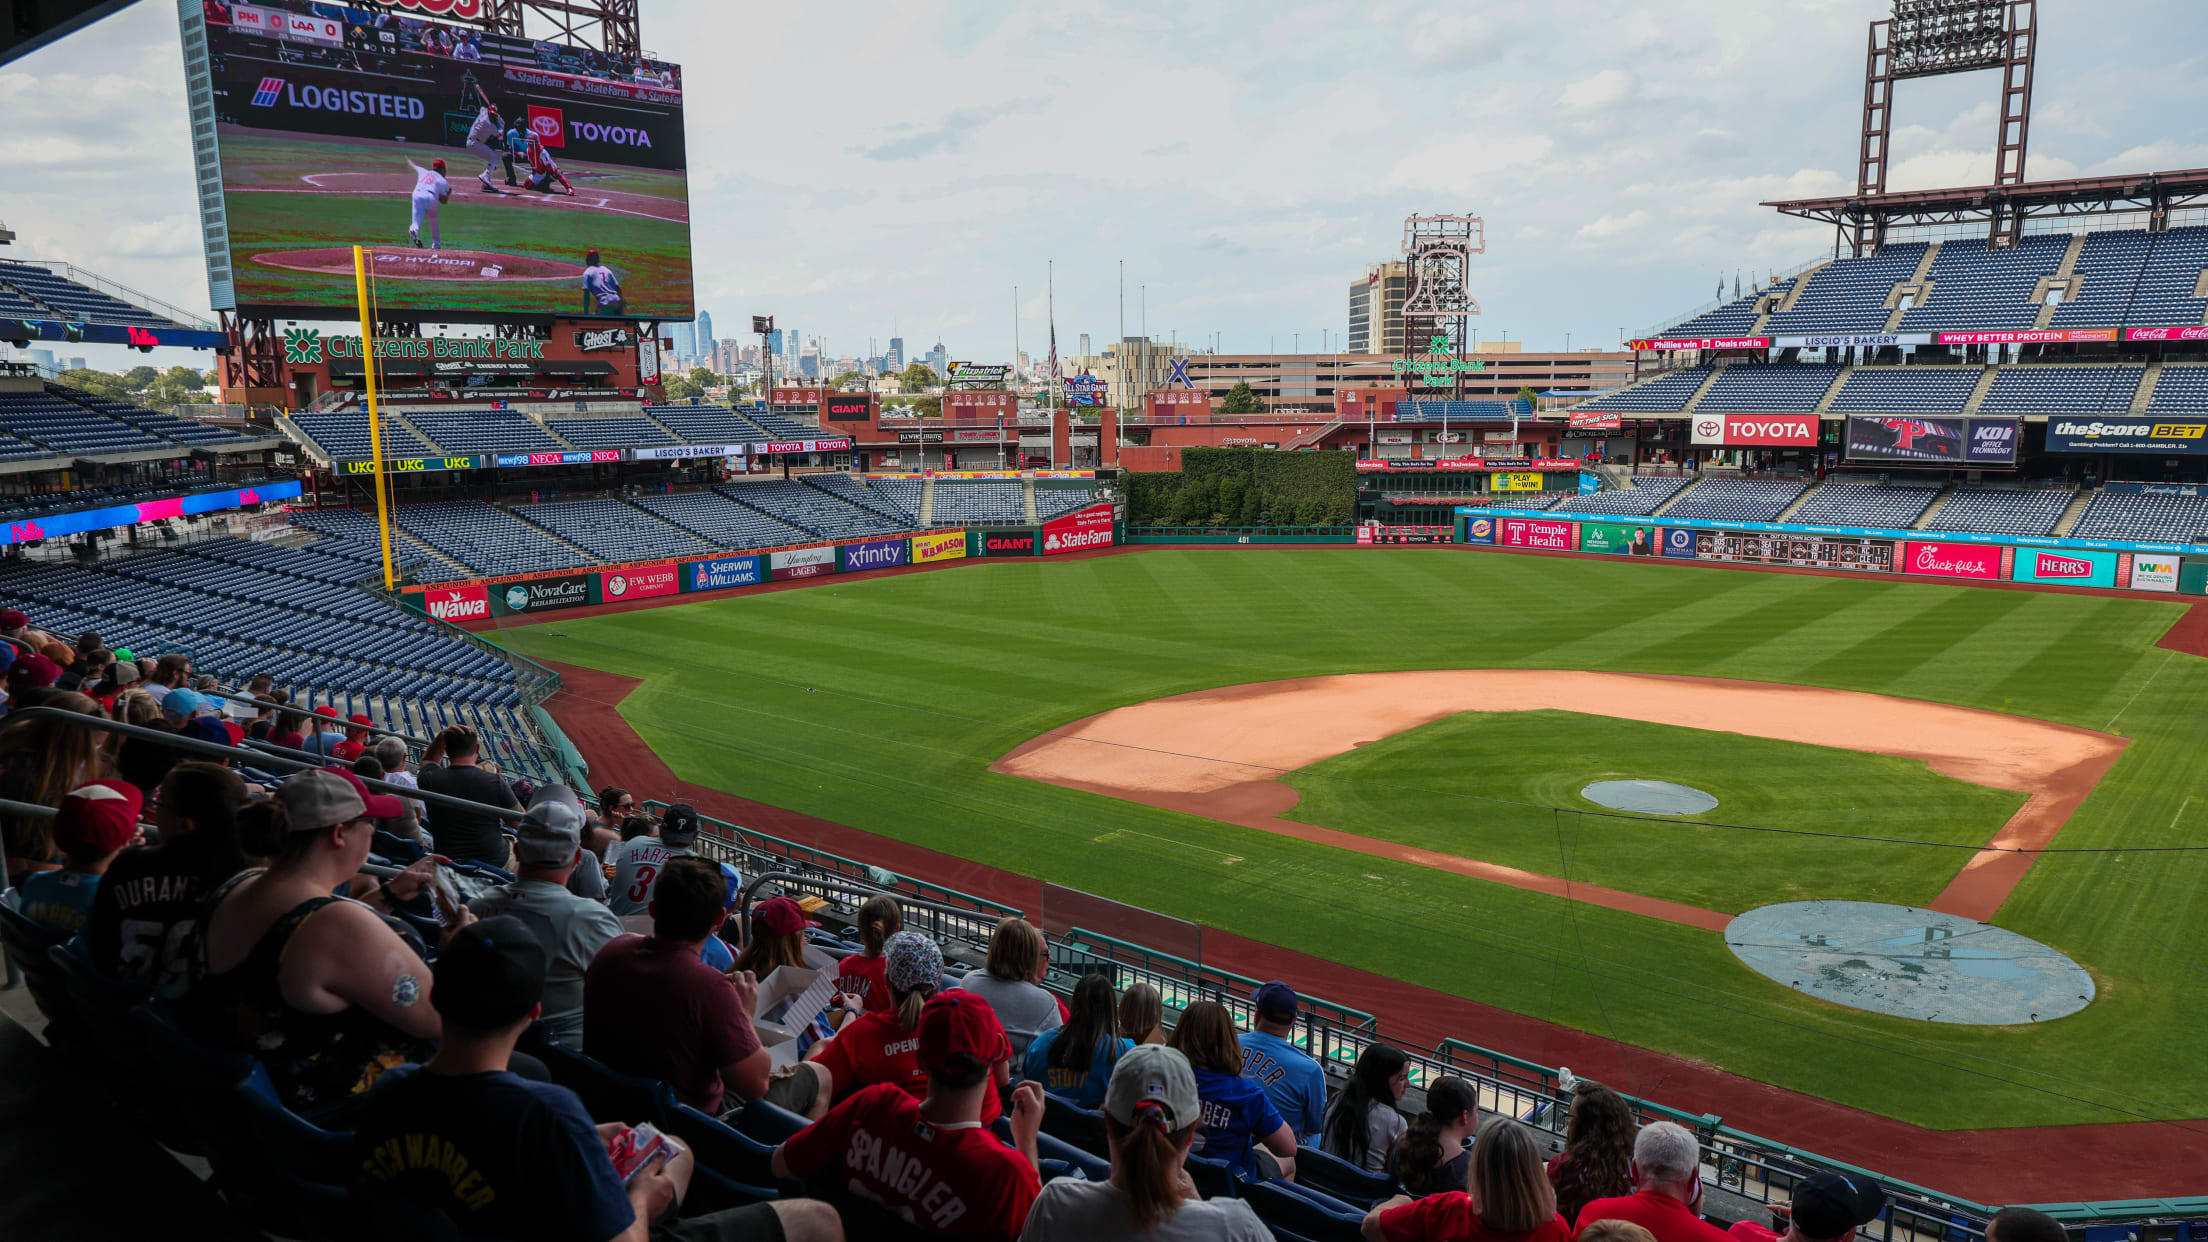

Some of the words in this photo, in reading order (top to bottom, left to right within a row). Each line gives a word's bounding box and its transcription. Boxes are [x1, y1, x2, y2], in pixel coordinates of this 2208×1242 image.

[238, 12, 258, 23] PHI
[271, 16, 282, 28] 0
[292, 20, 315, 32] LAA
[326, 24, 335, 36] 0
[288, 83, 424, 120] LOGISTEED
[570, 121, 652, 147] TOYOTA
[406, 256, 475, 266] HYUNDAI
[584, 329, 618, 350] GHOST
[1805, 336, 1850, 346] LISCIO'S
[1854, 335, 1898, 345] BAKERY
[1943, 334, 1974, 344] WHEY
[1977, 333, 2014, 342] BETTER
[2017, 331, 2062, 341] PROTEIN
[327, 334, 429, 358] Citzens
[434, 336, 490, 358] Bank
[495, 338, 544, 359] Park
[1654, 340, 1683, 349] Phillies
[1715, 339, 1736, 348] Deals
[1738, 339, 1752, 347] roll
[1753, 339, 1761, 347] in
[953, 363, 1004, 376] Fitzpatrick
[1394, 359, 1447, 372] Citizens
[1451, 359, 1484, 372] Bank
[1424, 374, 1453, 387] Park
[1075, 384, 1090, 392] STAR
[1091, 384, 1108, 392] GAME
[776, 392, 784, 400] P
[792, 392, 800, 400] P
[808, 392, 815, 400] P
[832, 405, 866, 413] GIANT
[1584, 416, 1601, 425] THIS
[1730, 422, 1810, 438] TOYOTA
[2055, 422, 2149, 436] theScore
[2157, 426, 2201, 436] BET
[770, 442, 801, 452] TOYOTA
[818, 440, 847, 449] TOYOTA
[1852, 443, 1878, 452] HOME
[594, 452, 619, 461] NECA
[655, 447, 690, 457] LISCIO'S
[694, 446, 726, 456] BAKERY
[444, 457, 470, 468] UKG
[532, 455, 560, 463] NECA
[348, 462, 376, 474] UKG
[397, 460, 424, 471] UKG
[1529, 523, 1568, 537] Temple
[987, 539, 1033, 550] GIANT
[1529, 536, 1564, 547] Health
[673, 554, 709, 564] ASPLUNDH
[849, 543, 900, 567] xfinity
[1860, 555, 1871, 563] CLE
[582, 564, 622, 574] ASPLUNDH
[629, 559, 666, 568] ASPLUNDH
[710, 560, 753, 574] SHERWIN
[2040, 559, 2086, 574] HERR'S
[2138, 563, 2173, 574] WM
[532, 569, 574, 580] ASPLUNDH
[791, 566, 816, 577] LAGER
[480, 574, 524, 585] ASPLUNDH
[630, 576, 646, 586] F.W.
[648, 573, 674, 584] WEBB
[424, 580, 471, 591] ASPLUNDH
[530, 582, 586, 599] NovaCare
[531, 596, 585, 608] REHABILITATION
[430, 599, 488, 619] Wawa
[677, 818, 688, 830] P
[632, 847, 672, 864] HARP
[628, 866, 656, 902] 3
[1241, 1047, 1285, 1086] RPER
[1198, 1109, 1232, 1130] BER
[846, 1127, 968, 1230] SPANGLER
